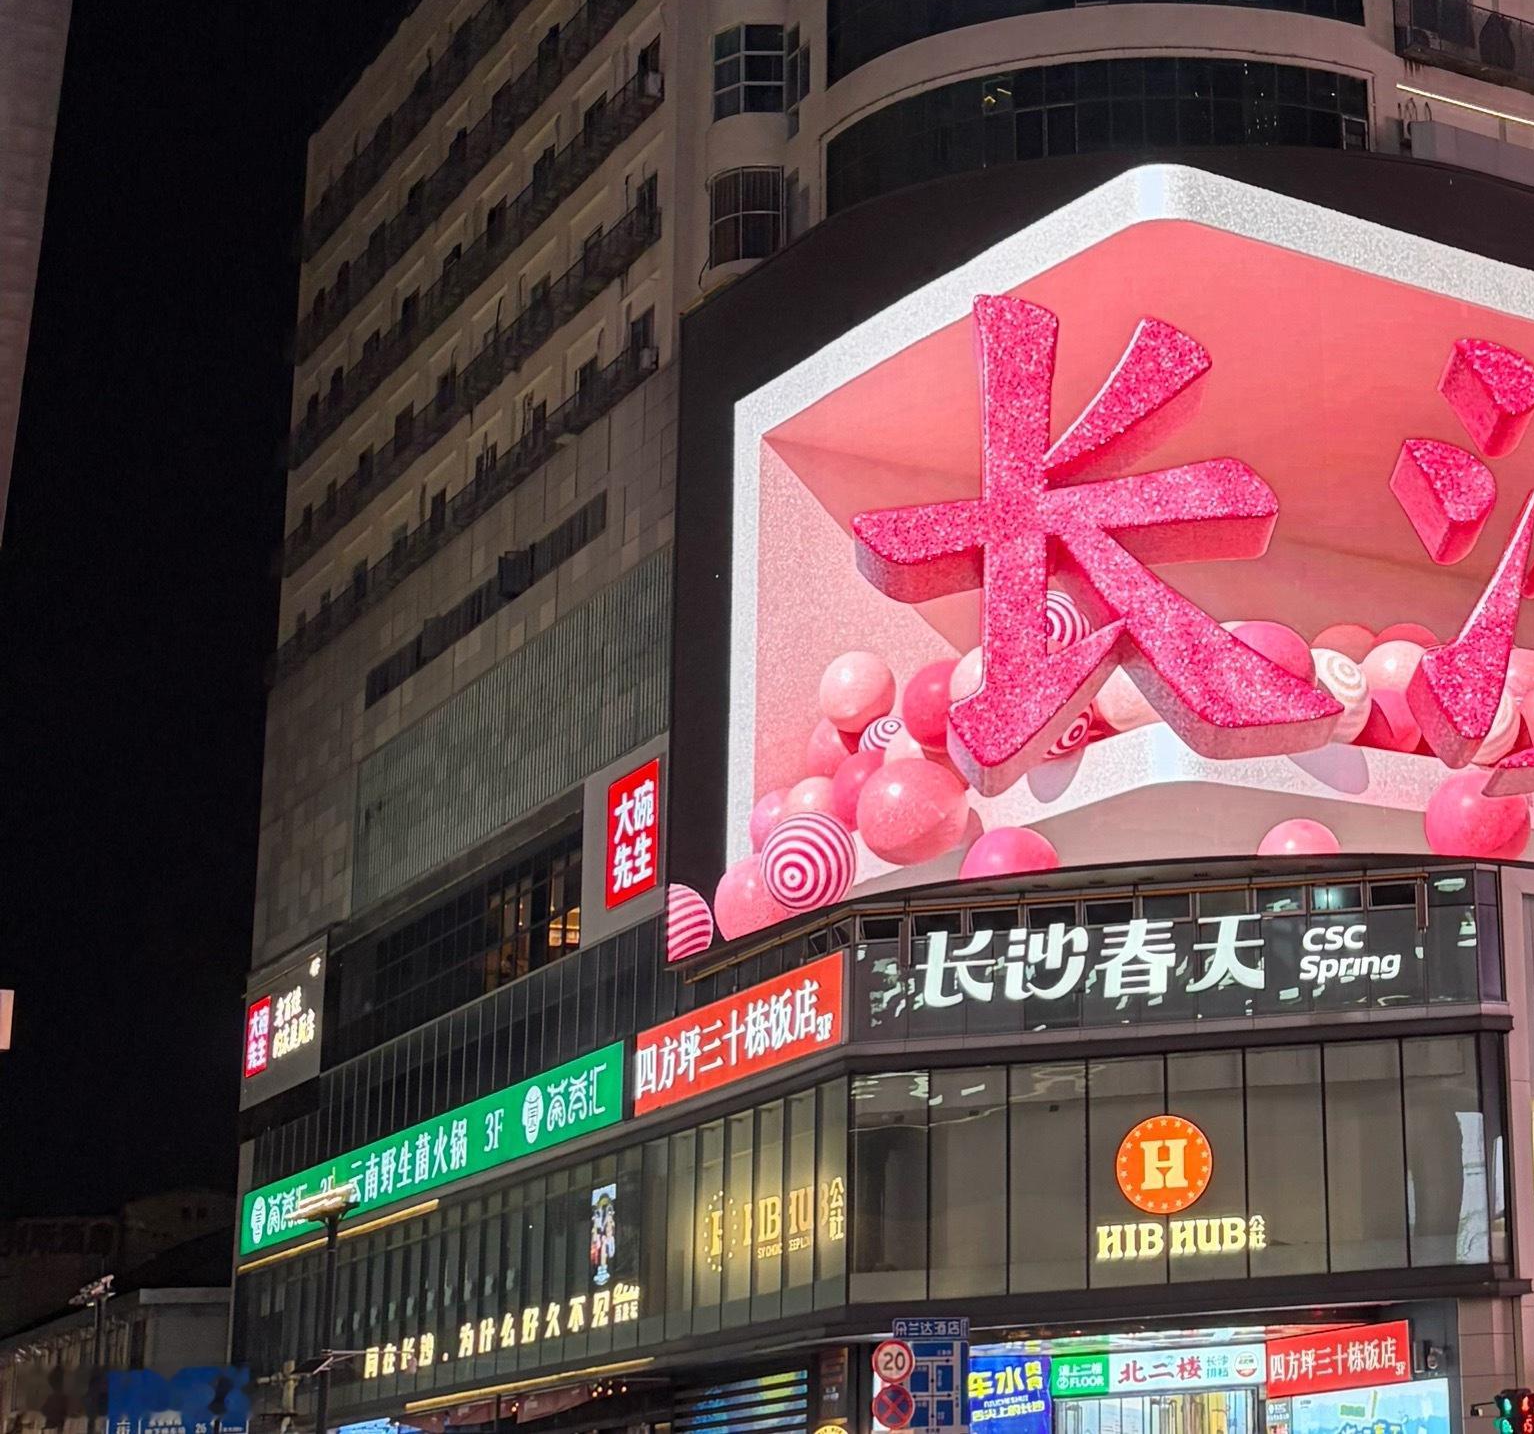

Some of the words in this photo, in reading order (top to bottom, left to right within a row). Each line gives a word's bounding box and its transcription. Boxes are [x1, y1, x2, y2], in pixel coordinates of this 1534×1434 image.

[614, 779, 655, 841] 大碗
[613, 833, 653, 893] 先生
[914, 913, 1266, 1008] 长沙春天
[1303, 924, 1367, 952] CSC
[1298, 952, 1402, 984] Spring
[636, 978, 820, 1100] 四方坪三十栋饭店
[815, 1013, 833, 1043] 3F
[483, 1109, 506, 1153] 3F
[1096, 1221, 1164, 1263] HIB
[1170, 1216, 1247, 1258] HUB
[895, 1320, 961, 1337] 朵兰达酒店
[883, 1351, 906, 1371] 20
[1117, 1355, 1203, 1385] 北二楼
[1270, 1336, 1397, 1384] 四方坪三十栋饭店
